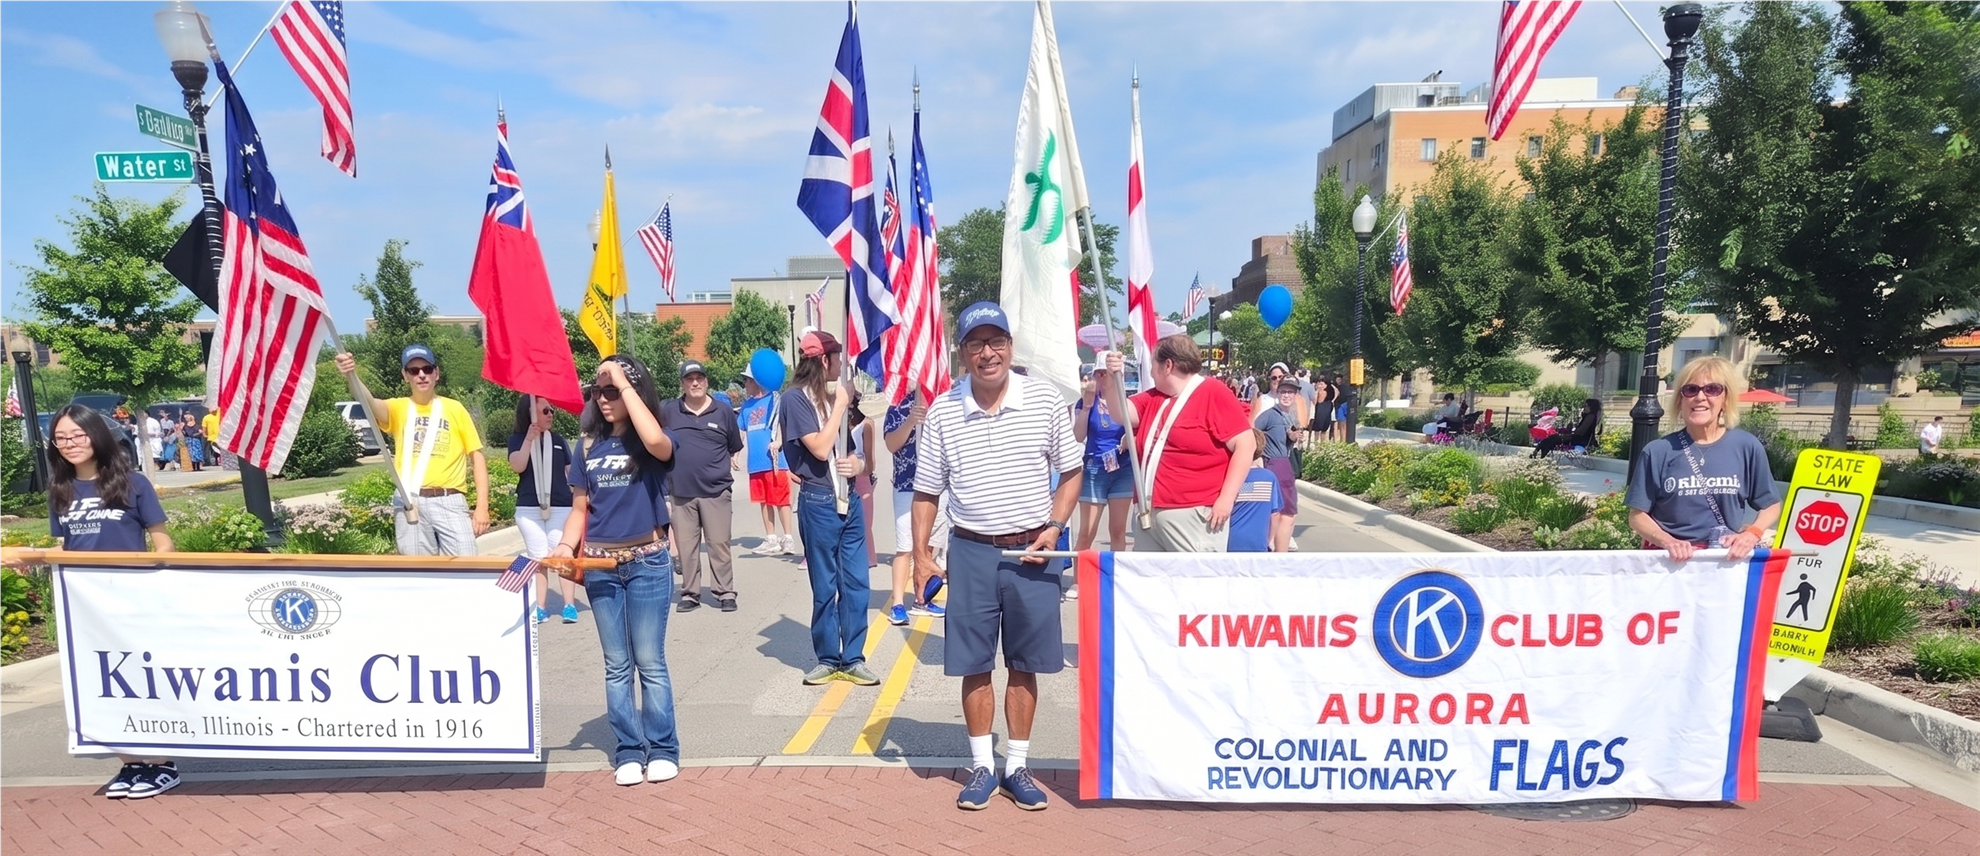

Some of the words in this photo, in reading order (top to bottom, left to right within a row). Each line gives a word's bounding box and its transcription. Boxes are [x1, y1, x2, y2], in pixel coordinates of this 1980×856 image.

[102, 155, 167, 178] Water
[173, 159, 187, 172] St
[1813, 454, 1866, 474] STATE
[1815, 472, 1853, 489] LAW
[1797, 512, 1846, 534] STOP
[1178, 613, 1358, 648] KIWANIS
[1490, 613, 1605, 648] CLUB
[1626, 610, 1681, 646] OF
[94, 650, 332, 703] Kiwanis
[360, 654, 502, 705] Club
[1318, 692, 1530, 725] AURORA
[122, 714, 196, 738] Aurora,
[202, 716, 274, 738] Illinois
[297, 717, 398, 738] Chartered
[406, 717, 425, 738] in
[435, 717, 483, 739] 1916
[1214, 737, 1367, 762] COLONIAL
[1384, 738, 1448, 762] AND
[1489, 736, 1629, 791] FLAGS
[1207, 766, 1456, 791] REVOLUTIONARY
